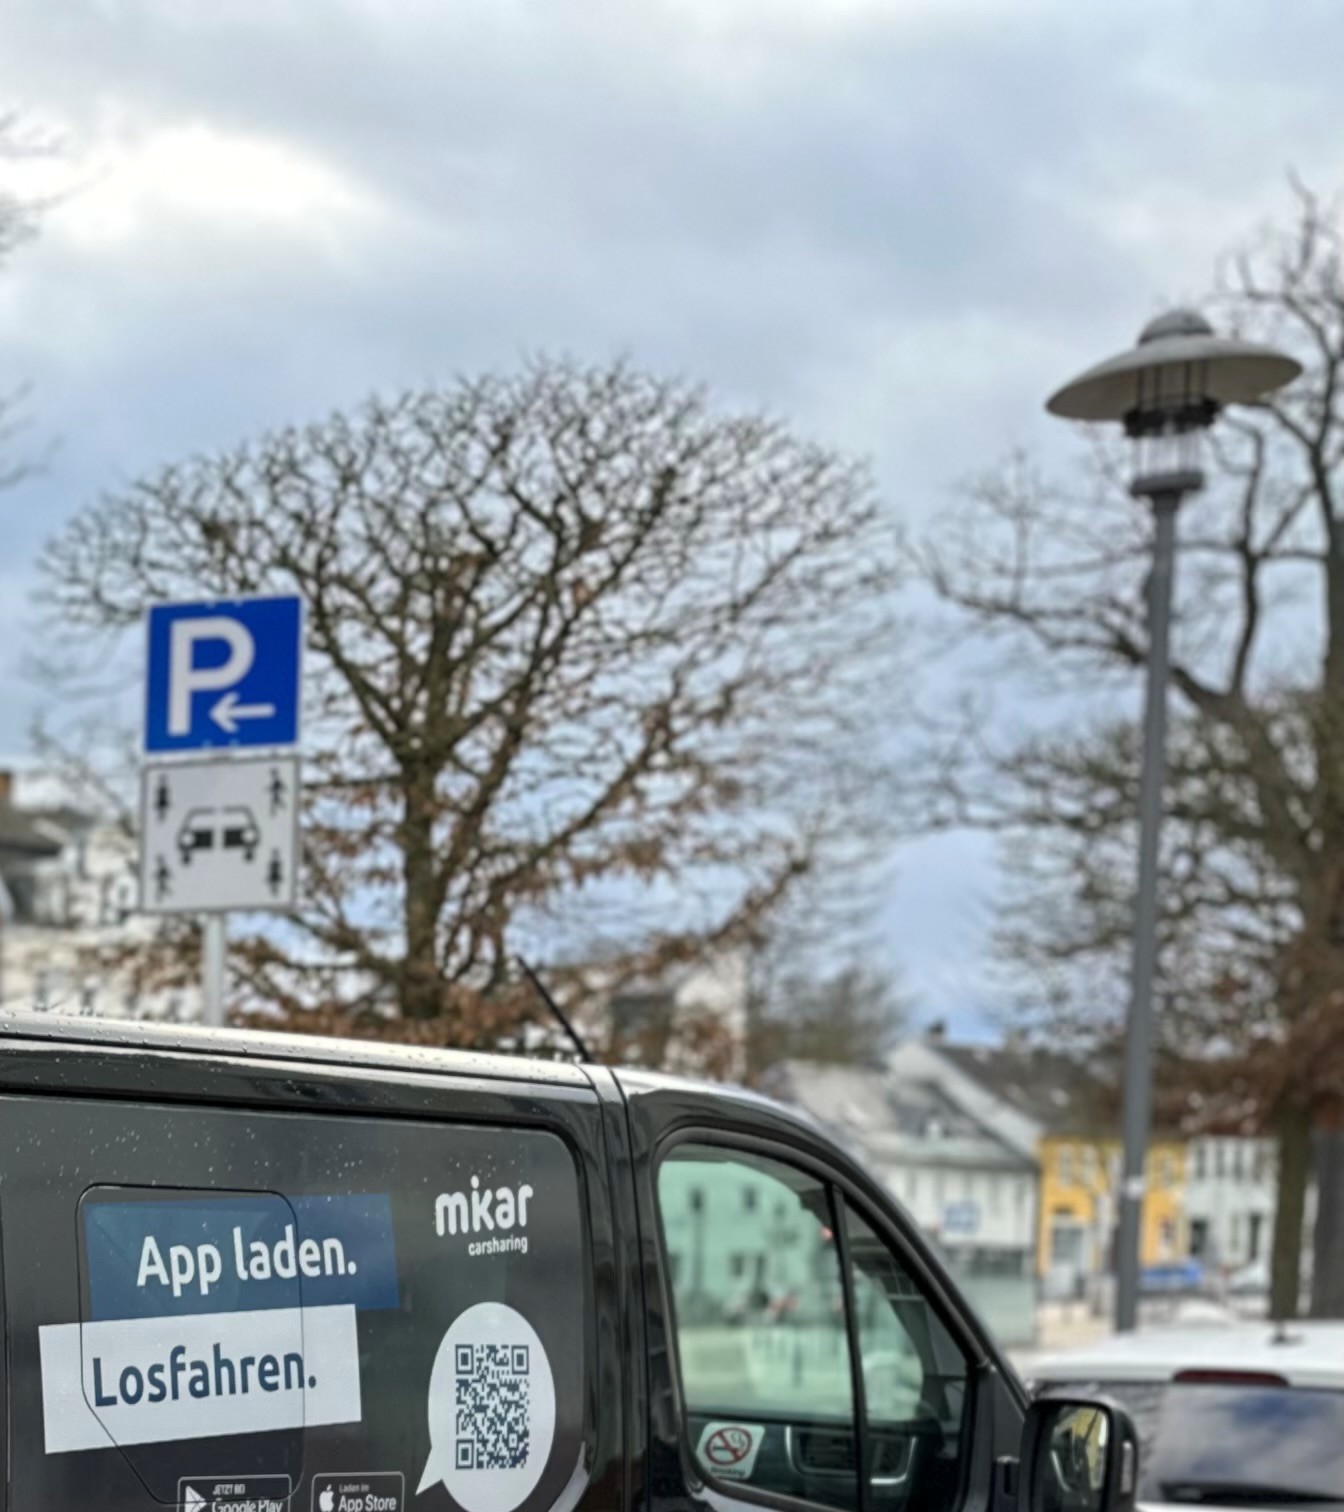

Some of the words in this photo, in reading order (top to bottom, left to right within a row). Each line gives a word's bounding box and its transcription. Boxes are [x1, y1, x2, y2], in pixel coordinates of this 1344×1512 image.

[168, 616, 255, 736] P
[434, 1176, 533, 1237] mikar
[136, 1235, 221, 1296] App
[234, 1226, 357, 1281] laden.
[467, 1234, 529, 1257] carsharing
[93, 1342, 317, 1407] Losfahren.
[339, 1484, 359, 1493] Laden
[365, 1494, 397, 1512] Store
